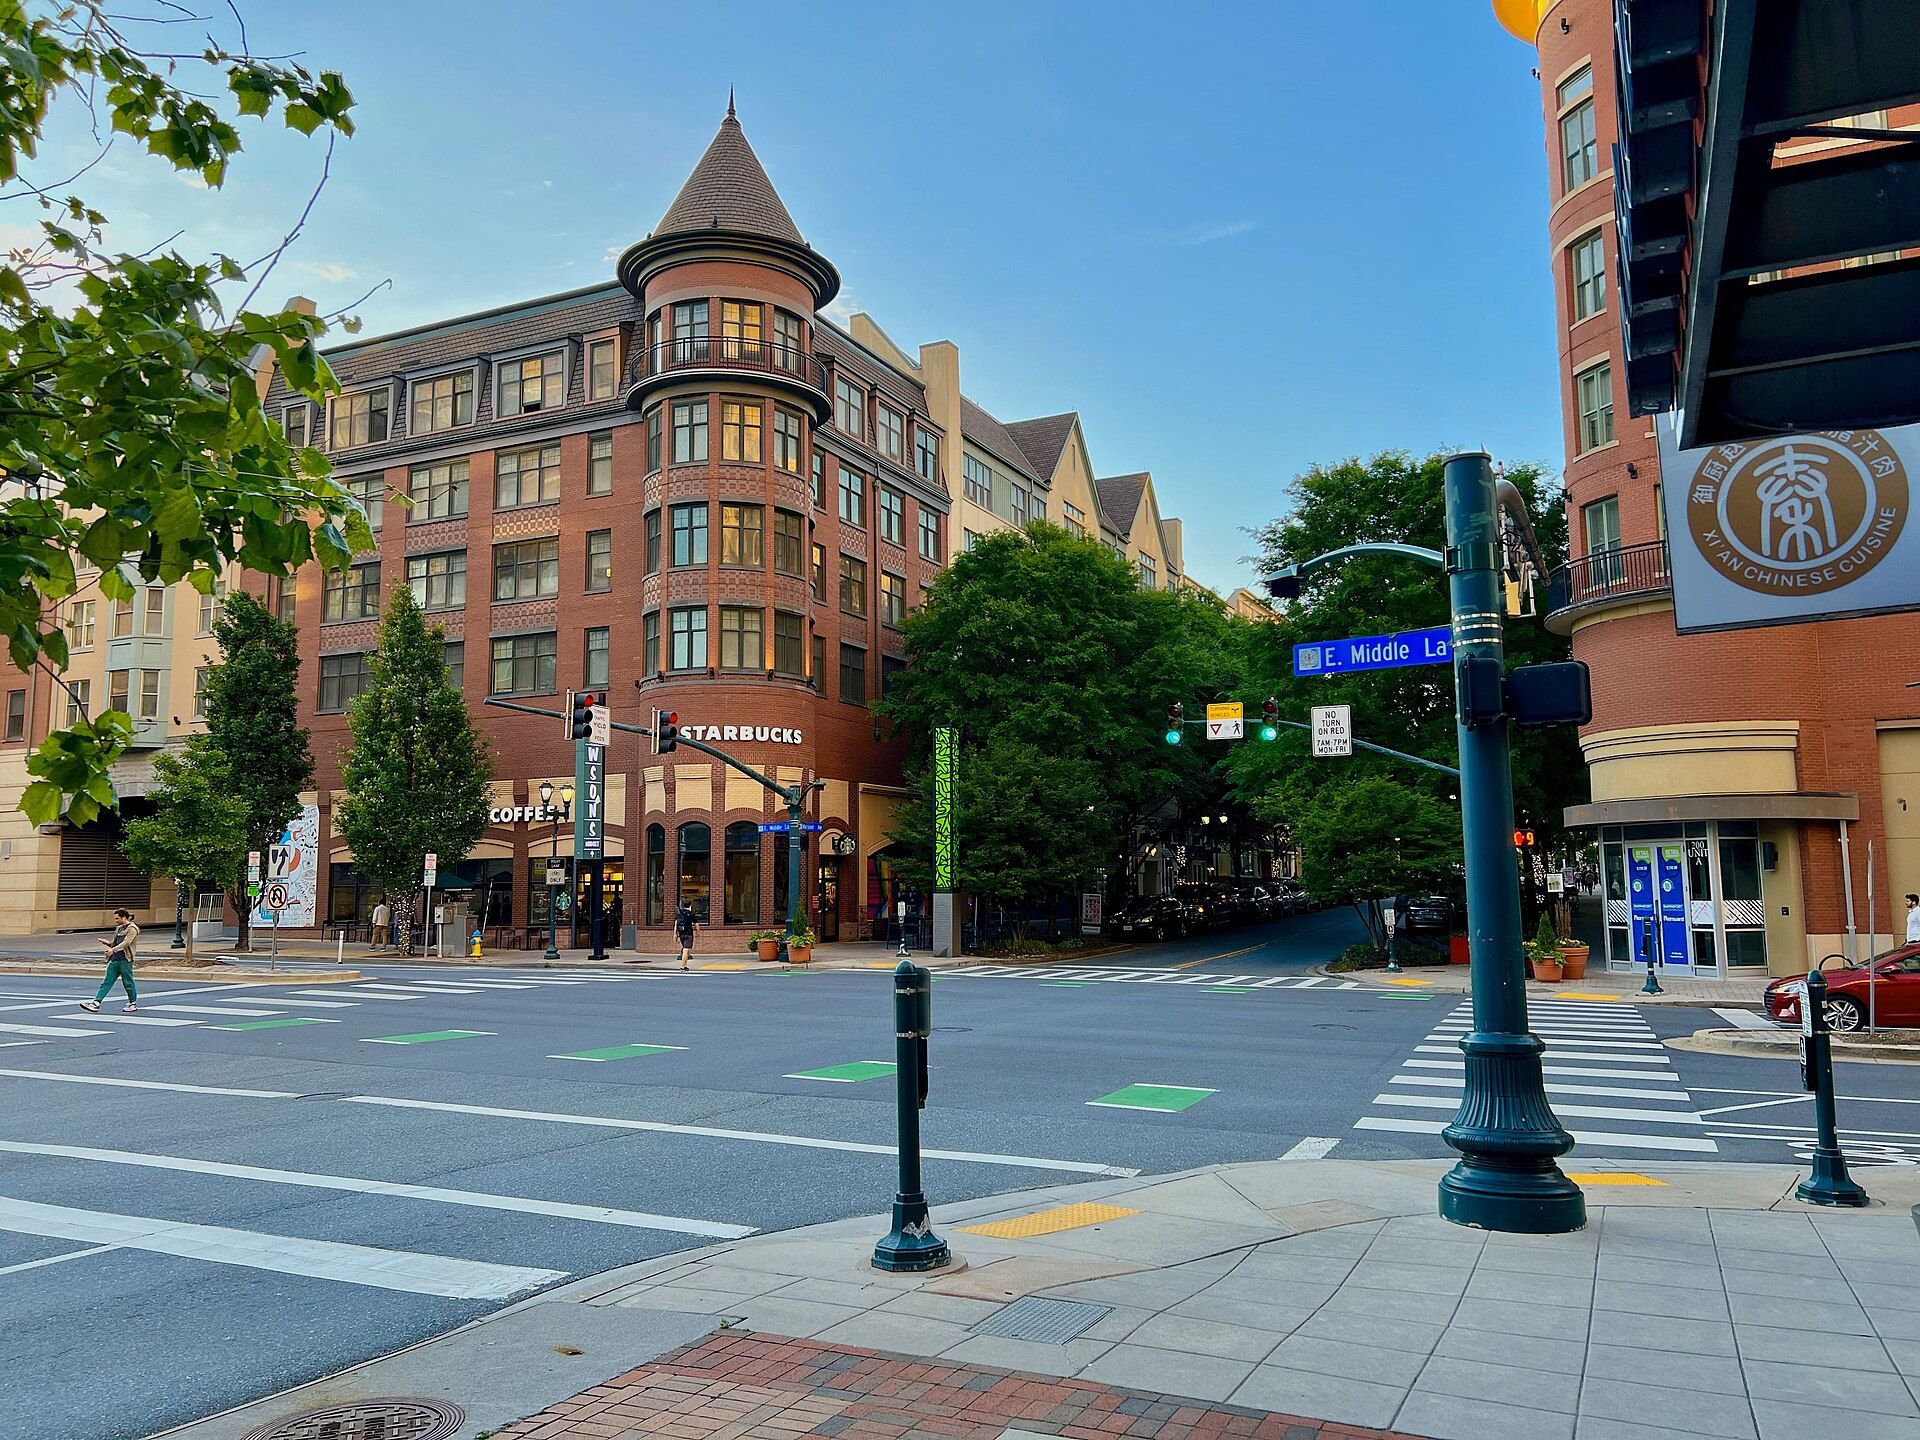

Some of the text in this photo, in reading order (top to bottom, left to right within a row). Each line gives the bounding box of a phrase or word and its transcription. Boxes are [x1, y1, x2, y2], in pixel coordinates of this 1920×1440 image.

[1702, 506, 1897, 587] XI'AN CHINESE CUISINE
[1325, 637, 1447, 667] E. Middle La
[1324, 710, 1336, 719] NO
[1322, 719, 1341, 727] TURN
[680, 725, 802, 744] STARBUCKS
[1330, 726, 1345, 735] RED
[1316, 739, 1348, 747] 7AM-7PM
[1318, 746, 1346, 754] MON-FRI
[1691, 841, 1704, 849] 200
[1688, 848, 1709, 857] UNIT
[1695, 857, 1702, 865] A
